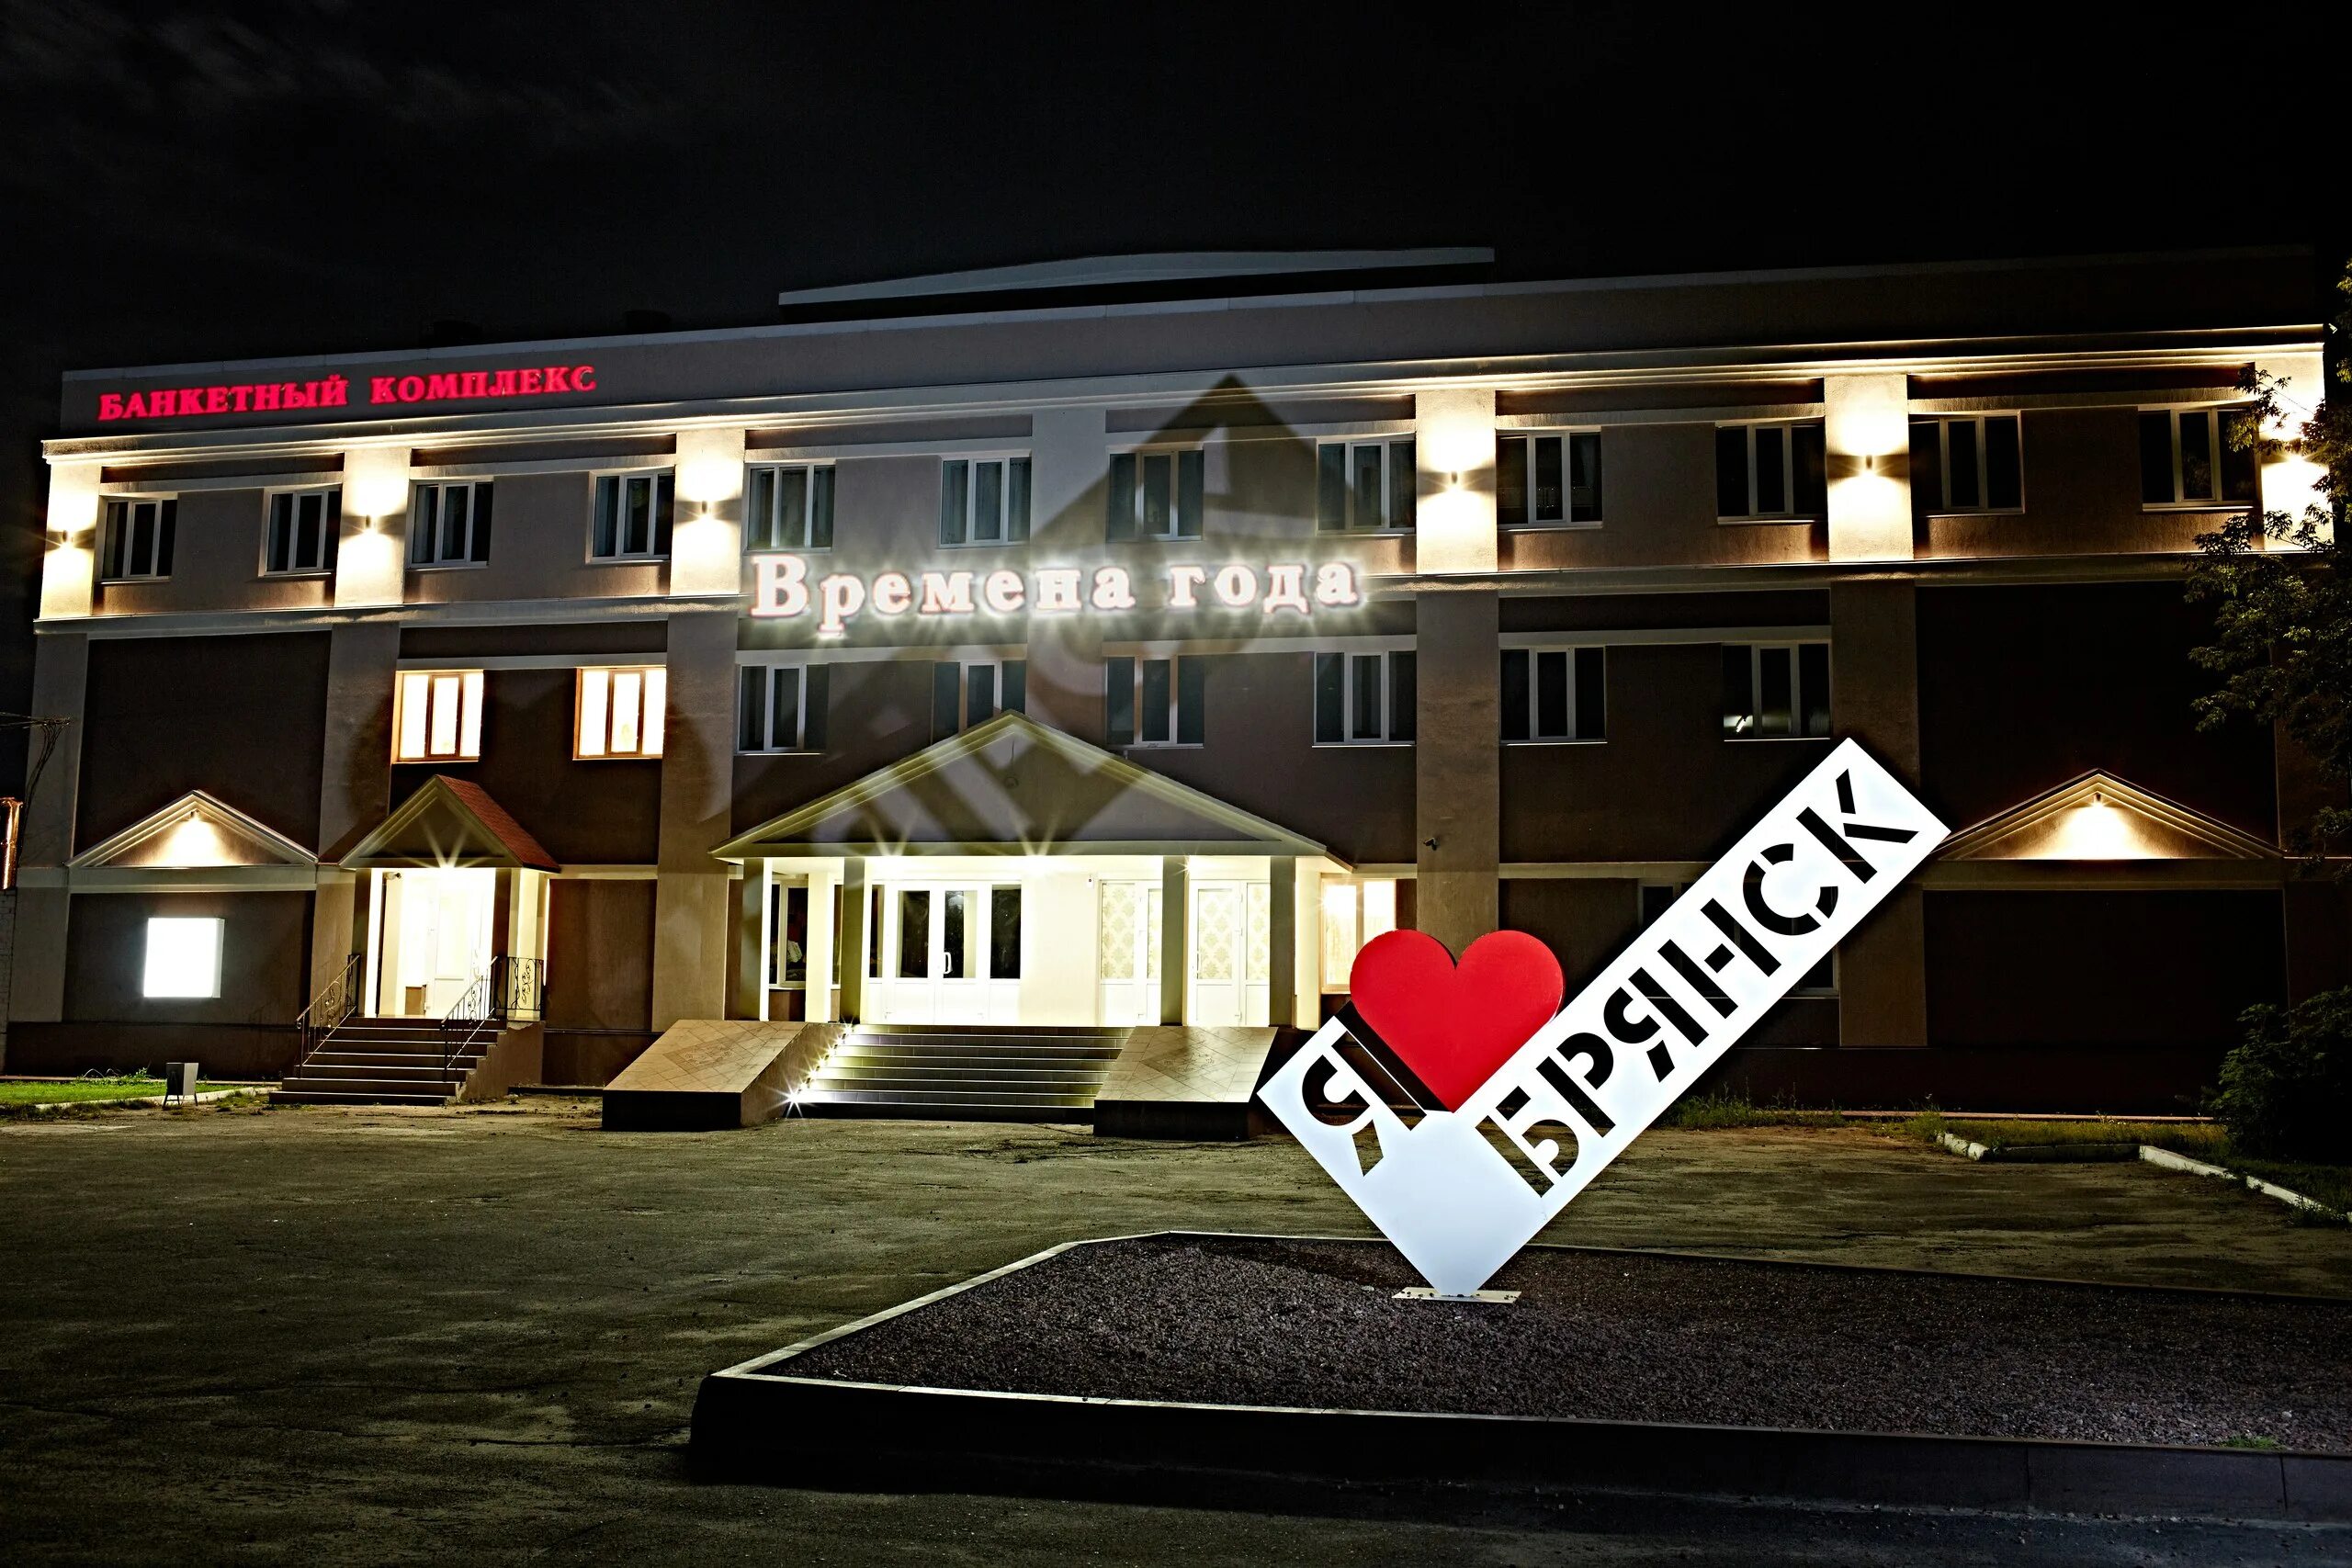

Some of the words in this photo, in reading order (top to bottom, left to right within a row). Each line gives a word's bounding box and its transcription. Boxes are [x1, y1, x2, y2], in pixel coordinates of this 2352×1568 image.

[98, 375, 348, 421] БАНКЕТНЫЙ
[370, 366, 596, 404] КОМПЛЕКС
[750, 554, 1136, 633] Времена
[1170, 562, 1358, 614] года
[1302, 1031, 1427, 1176] Я
[1476, 768, 1918, 1197] БРЯНСК
